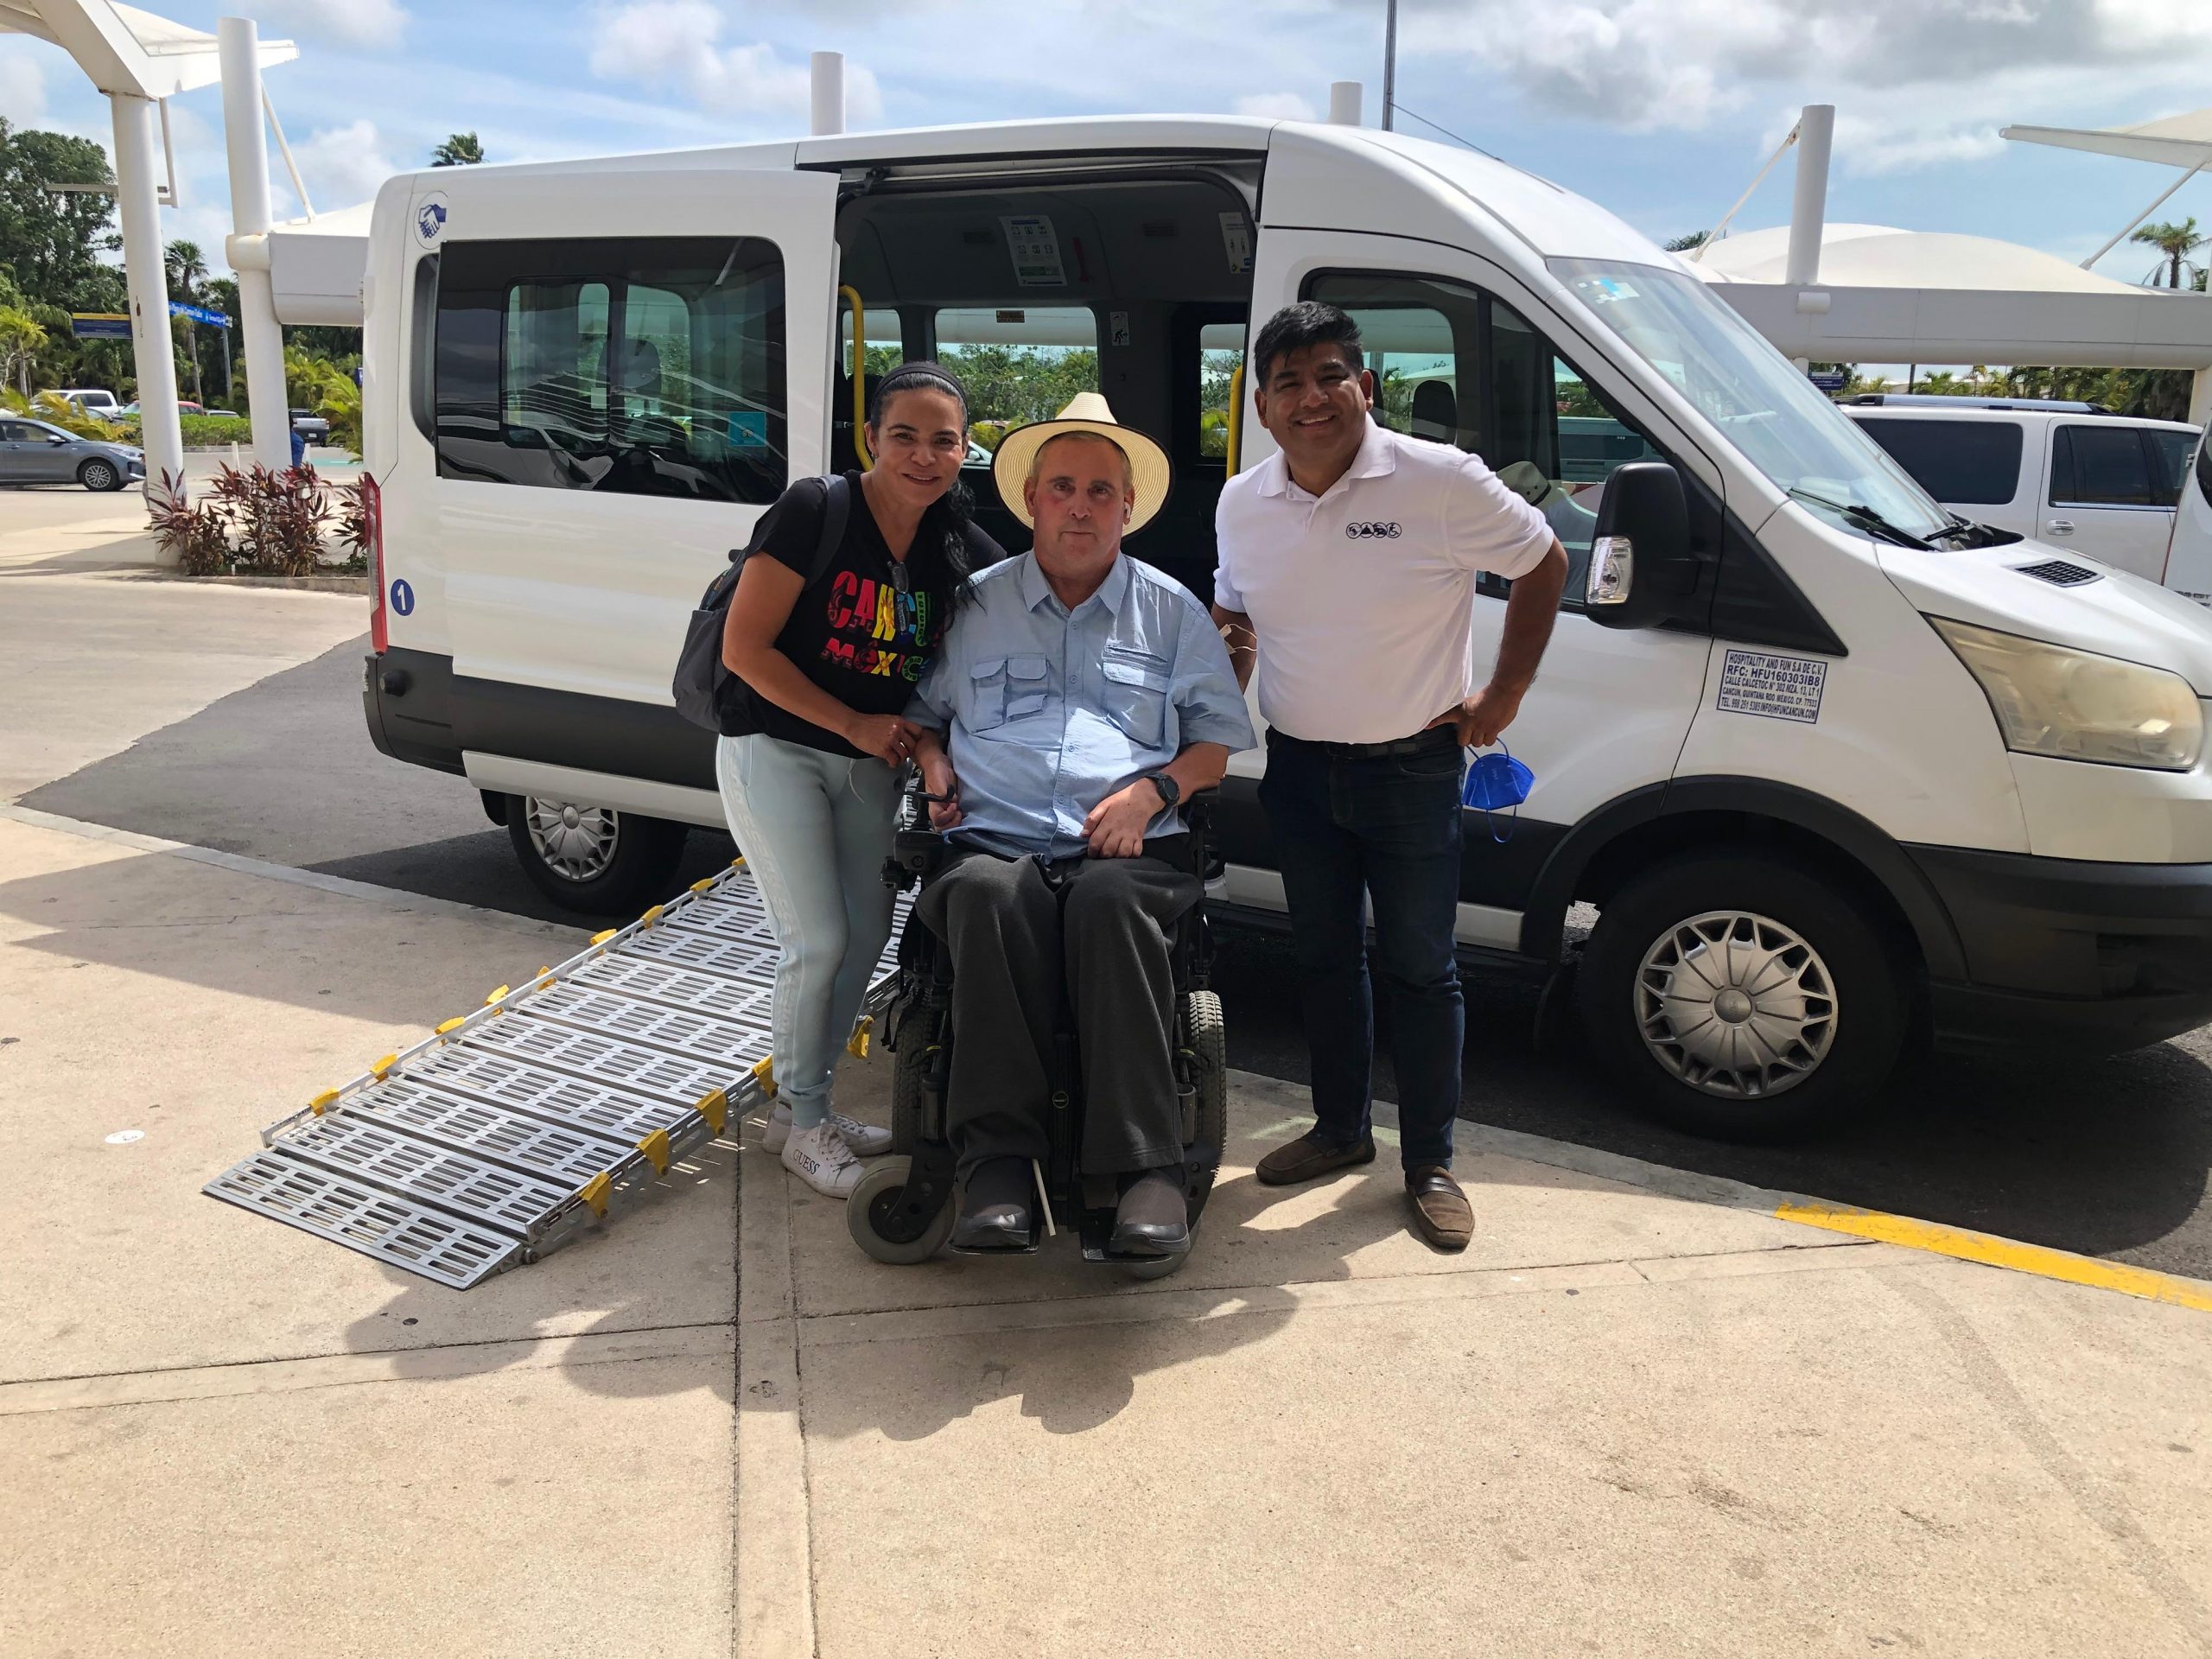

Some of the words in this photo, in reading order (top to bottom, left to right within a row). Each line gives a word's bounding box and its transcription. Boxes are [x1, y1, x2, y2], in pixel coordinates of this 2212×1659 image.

[397, 584, 406, 610] 1
[1729, 653, 1765, 667] HOSPITALITY
[1765, 658, 1778, 669] AND
[1779, 659, 1791, 671] FUN
[1802, 662, 1810, 673] DE
[1811, 664, 1822, 675] C.V.
[1725, 675, 1741, 685] CALLE
[1741, 677, 1768, 690] CALCETOC
[1808, 686, 1815, 696] LT
[1726, 665, 1748, 677] RFC:
[1751, 667, 1821, 686] HFU160303IB8
[1721, 697, 1731, 707] TEL.
[1742, 690, 1764, 699] QUINTANA
[793, 1149, 820, 1174] GUESS
